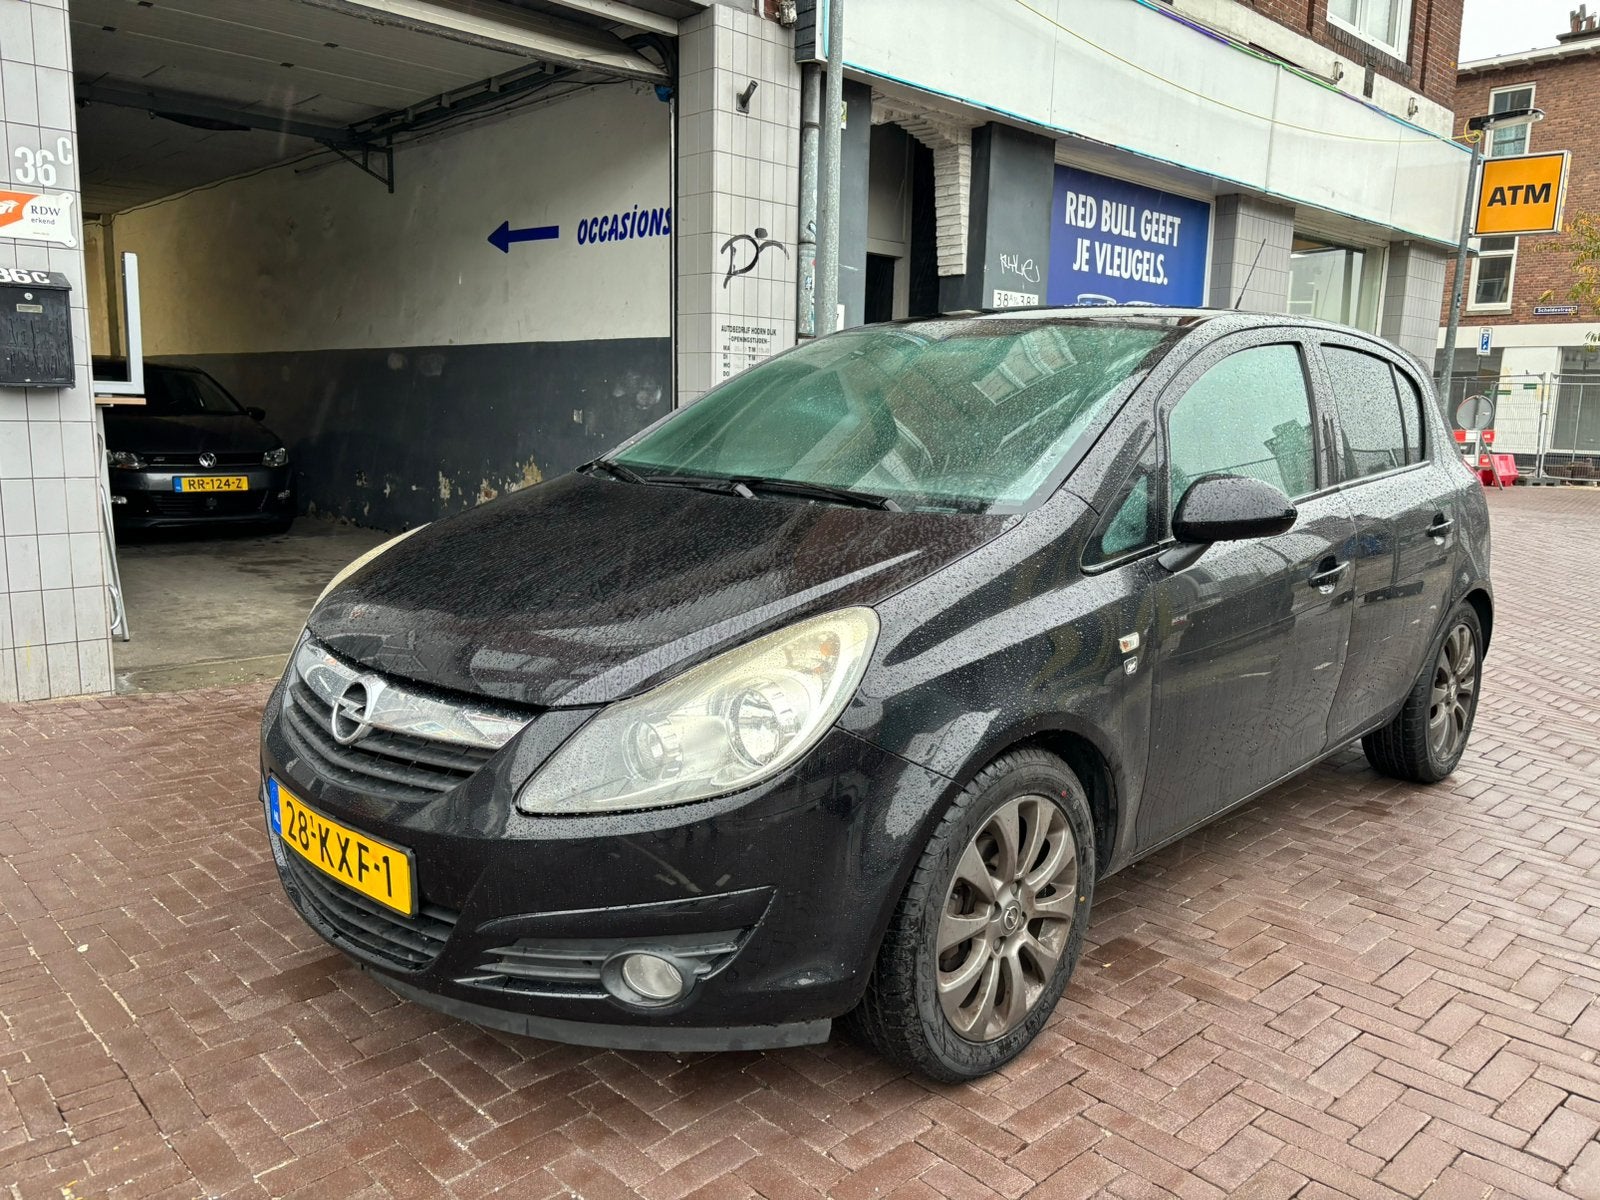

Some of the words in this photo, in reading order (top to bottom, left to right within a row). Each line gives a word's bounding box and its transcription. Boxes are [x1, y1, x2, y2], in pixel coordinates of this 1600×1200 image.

[1487, 183, 1552, 207] ATM
[31, 205, 61, 217] RDW
[31, 217, 55, 226] erkend
[1065, 191, 1097, 229] RED
[1101, 200, 1137, 238] BULL
[1141, 209, 1181, 247] GEEFT
[1073, 238, 1091, 272] JE
[1095, 241, 1168, 285] VLEUGELS.
[188, 478, 242, 490] RR-124-Z
[286, 800, 392, 898] 28-KXF-1
